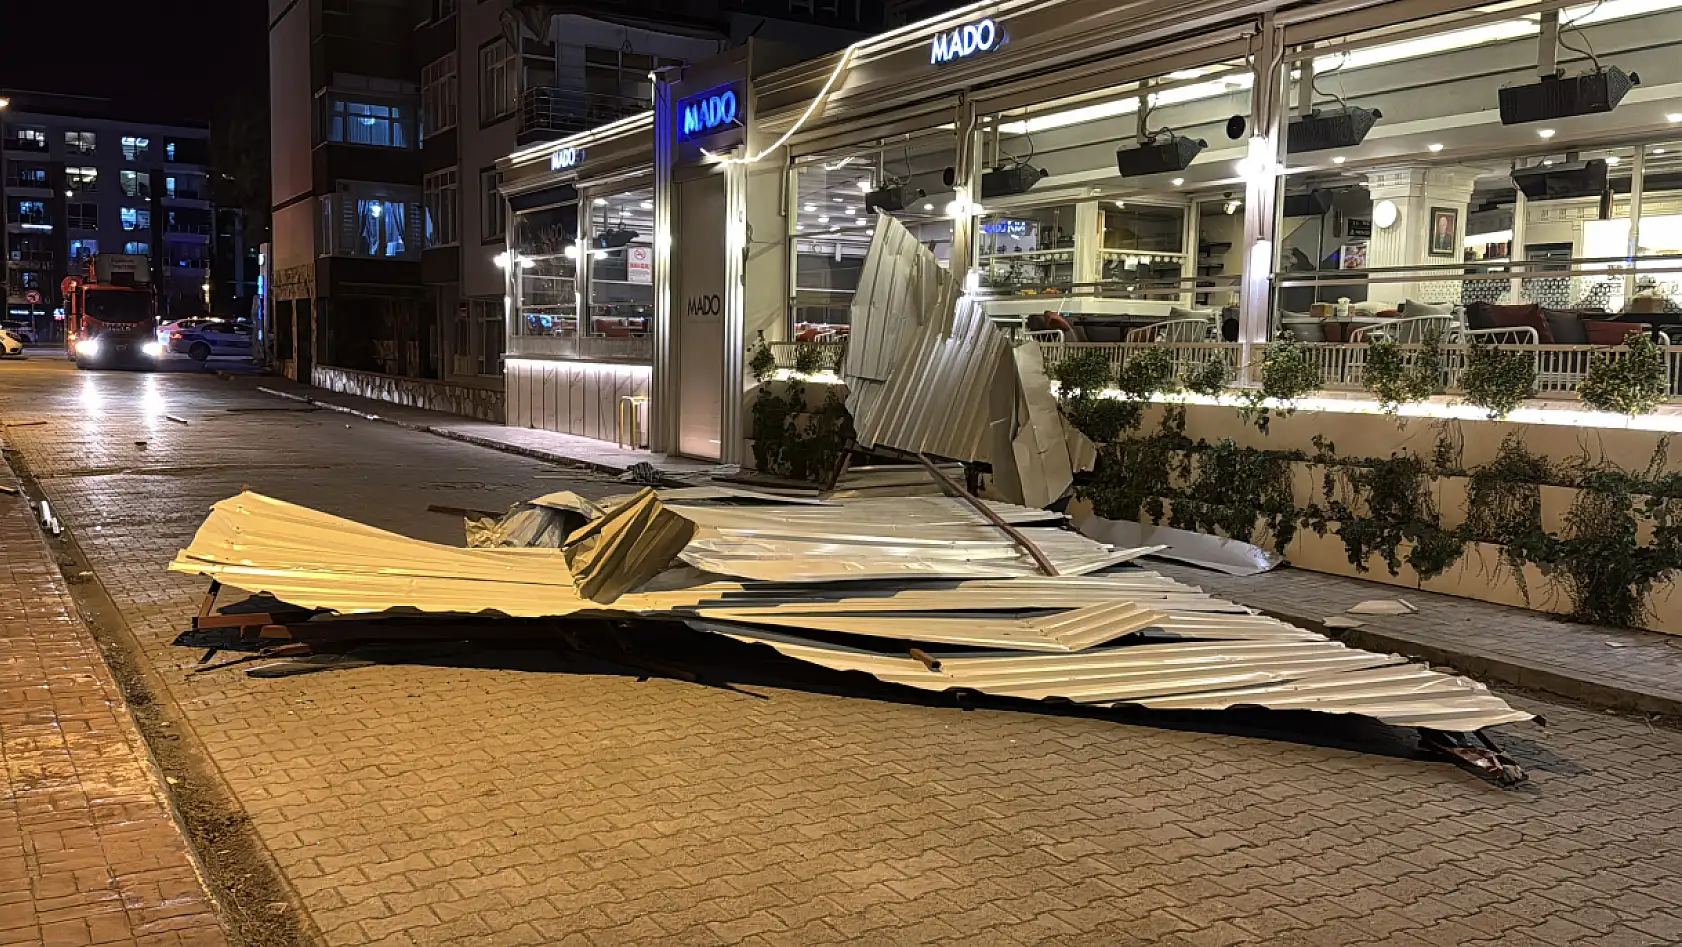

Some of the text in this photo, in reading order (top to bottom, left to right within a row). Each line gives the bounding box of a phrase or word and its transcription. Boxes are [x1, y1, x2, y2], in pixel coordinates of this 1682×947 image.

[930, 18, 995, 64] MADO
[684, 90, 736, 134] MADO
[551, 147, 576, 170] MADO
[687, 293, 721, 316] MADO
